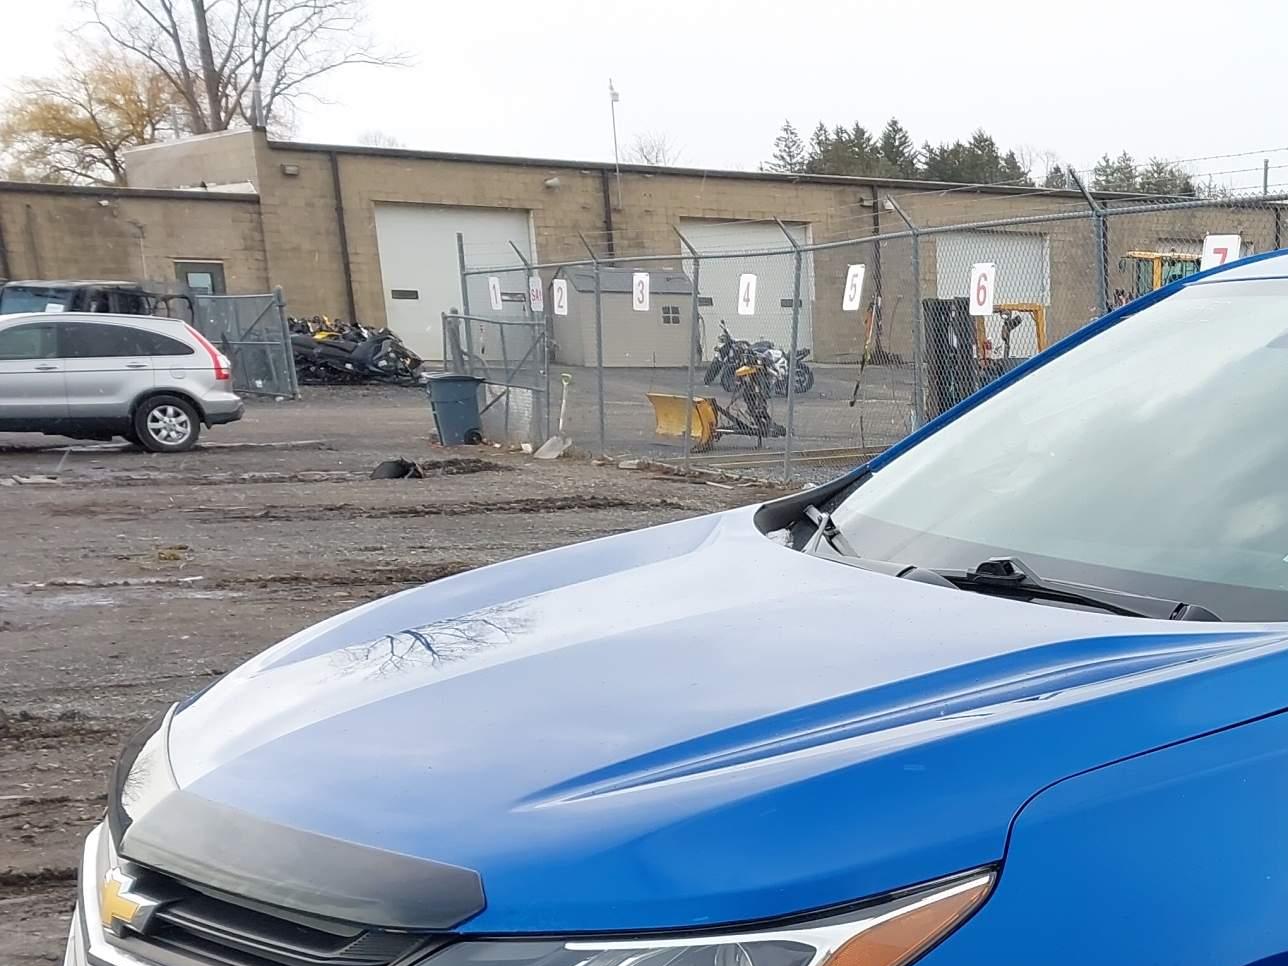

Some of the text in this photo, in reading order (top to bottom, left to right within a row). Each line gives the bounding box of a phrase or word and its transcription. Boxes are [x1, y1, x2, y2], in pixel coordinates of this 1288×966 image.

[492, 283, 499, 305] 1
[556, 286, 565, 309] 2
[637, 279, 645, 305] 3
[742, 280, 751, 308] 4
[849, 273, 859, 302] 5
[976, 272, 988, 307] 6
